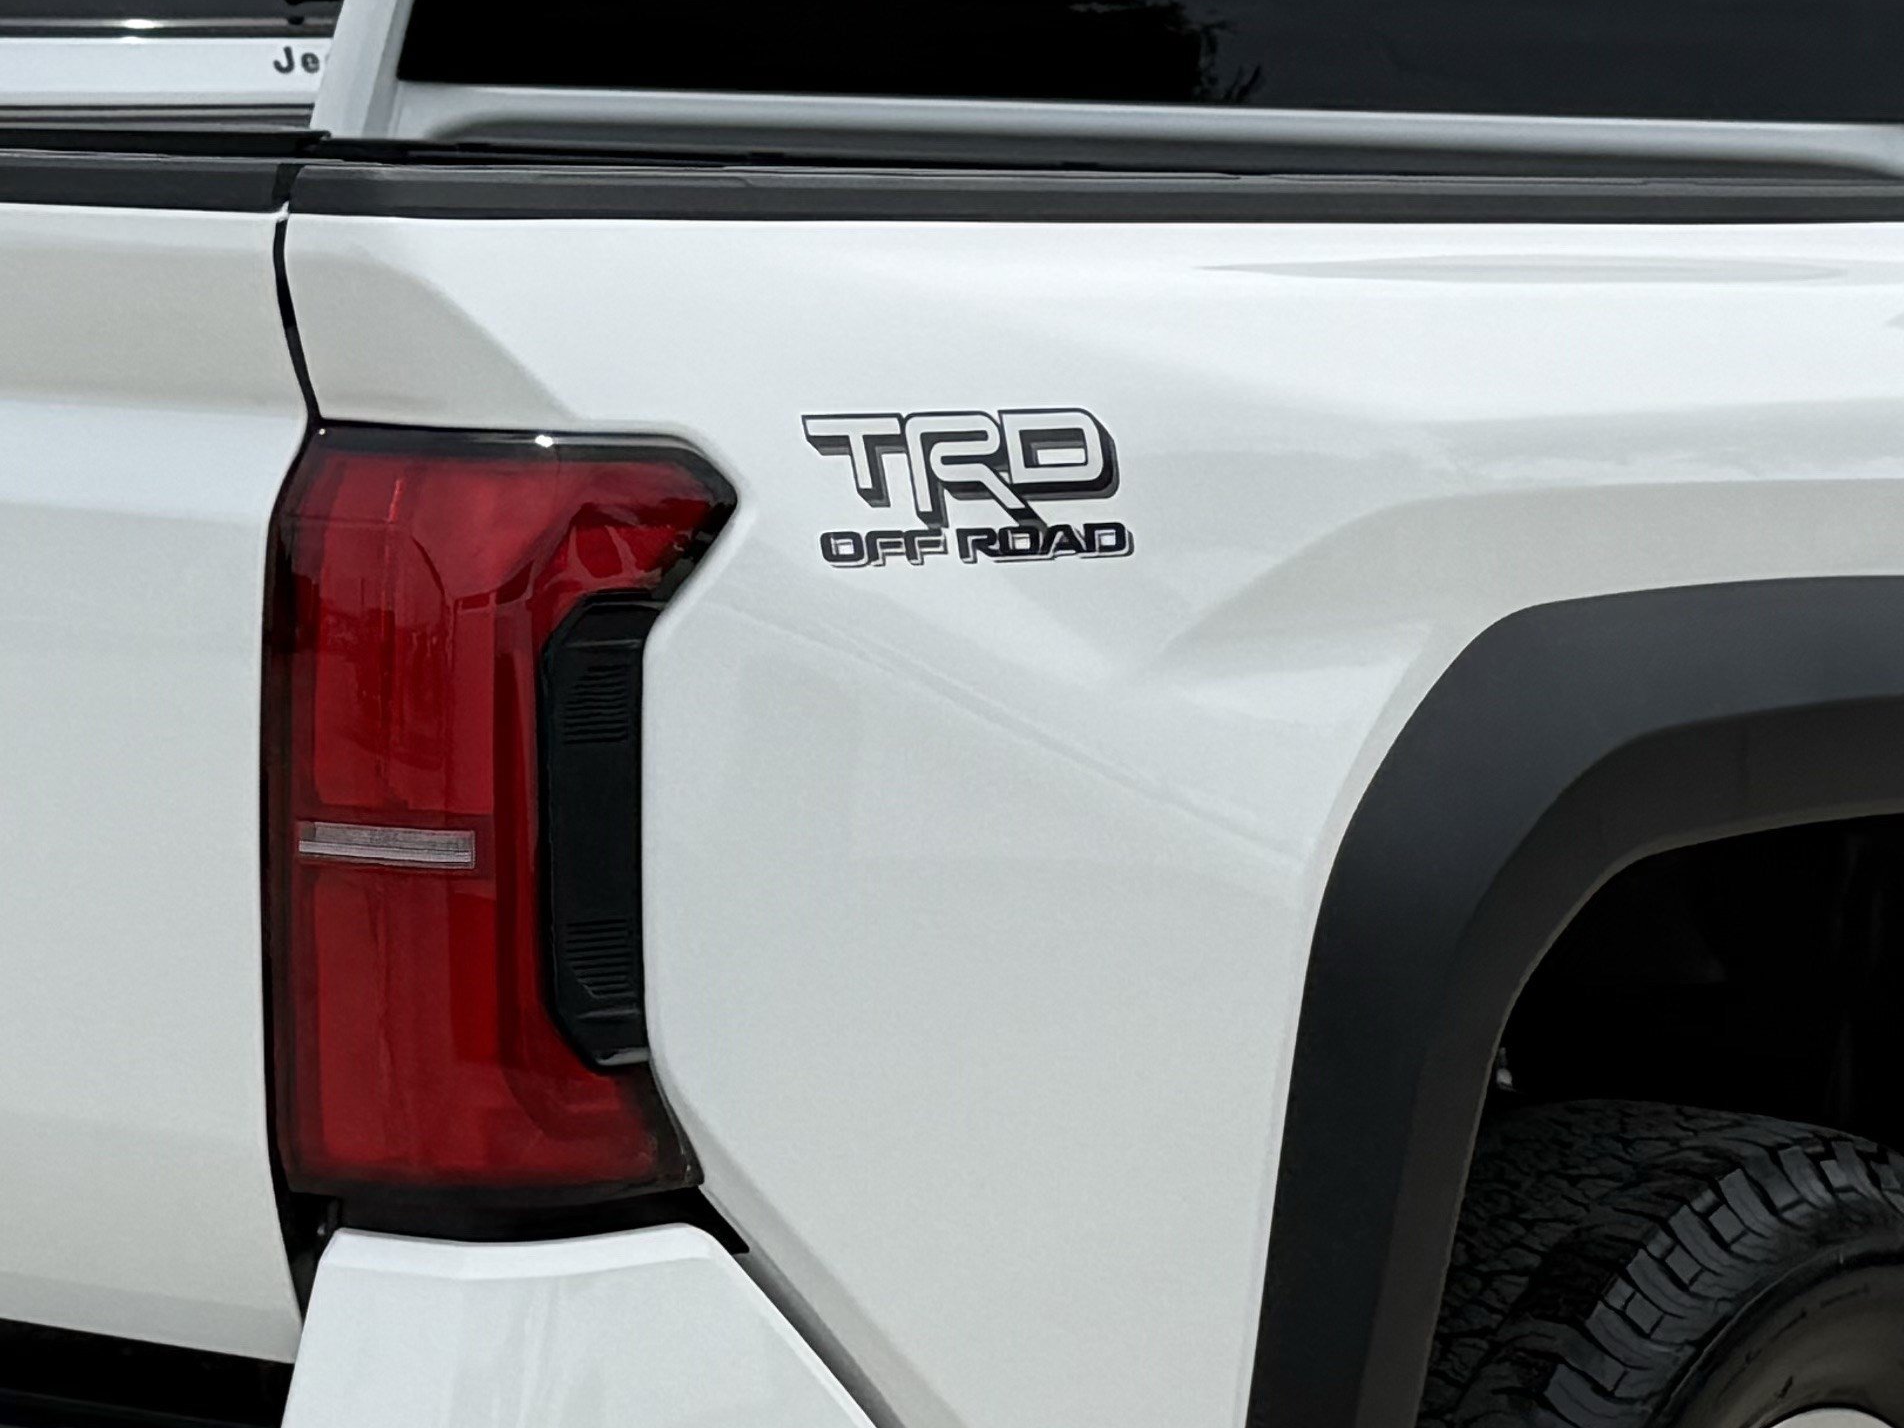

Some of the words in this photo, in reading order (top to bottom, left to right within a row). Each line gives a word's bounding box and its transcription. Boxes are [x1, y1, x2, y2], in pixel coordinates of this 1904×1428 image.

[273, 46, 321, 75] Je
[801, 407, 1120, 529] TRD
[819, 529, 948, 568] OFF
[955, 521, 1136, 565] ROAD
